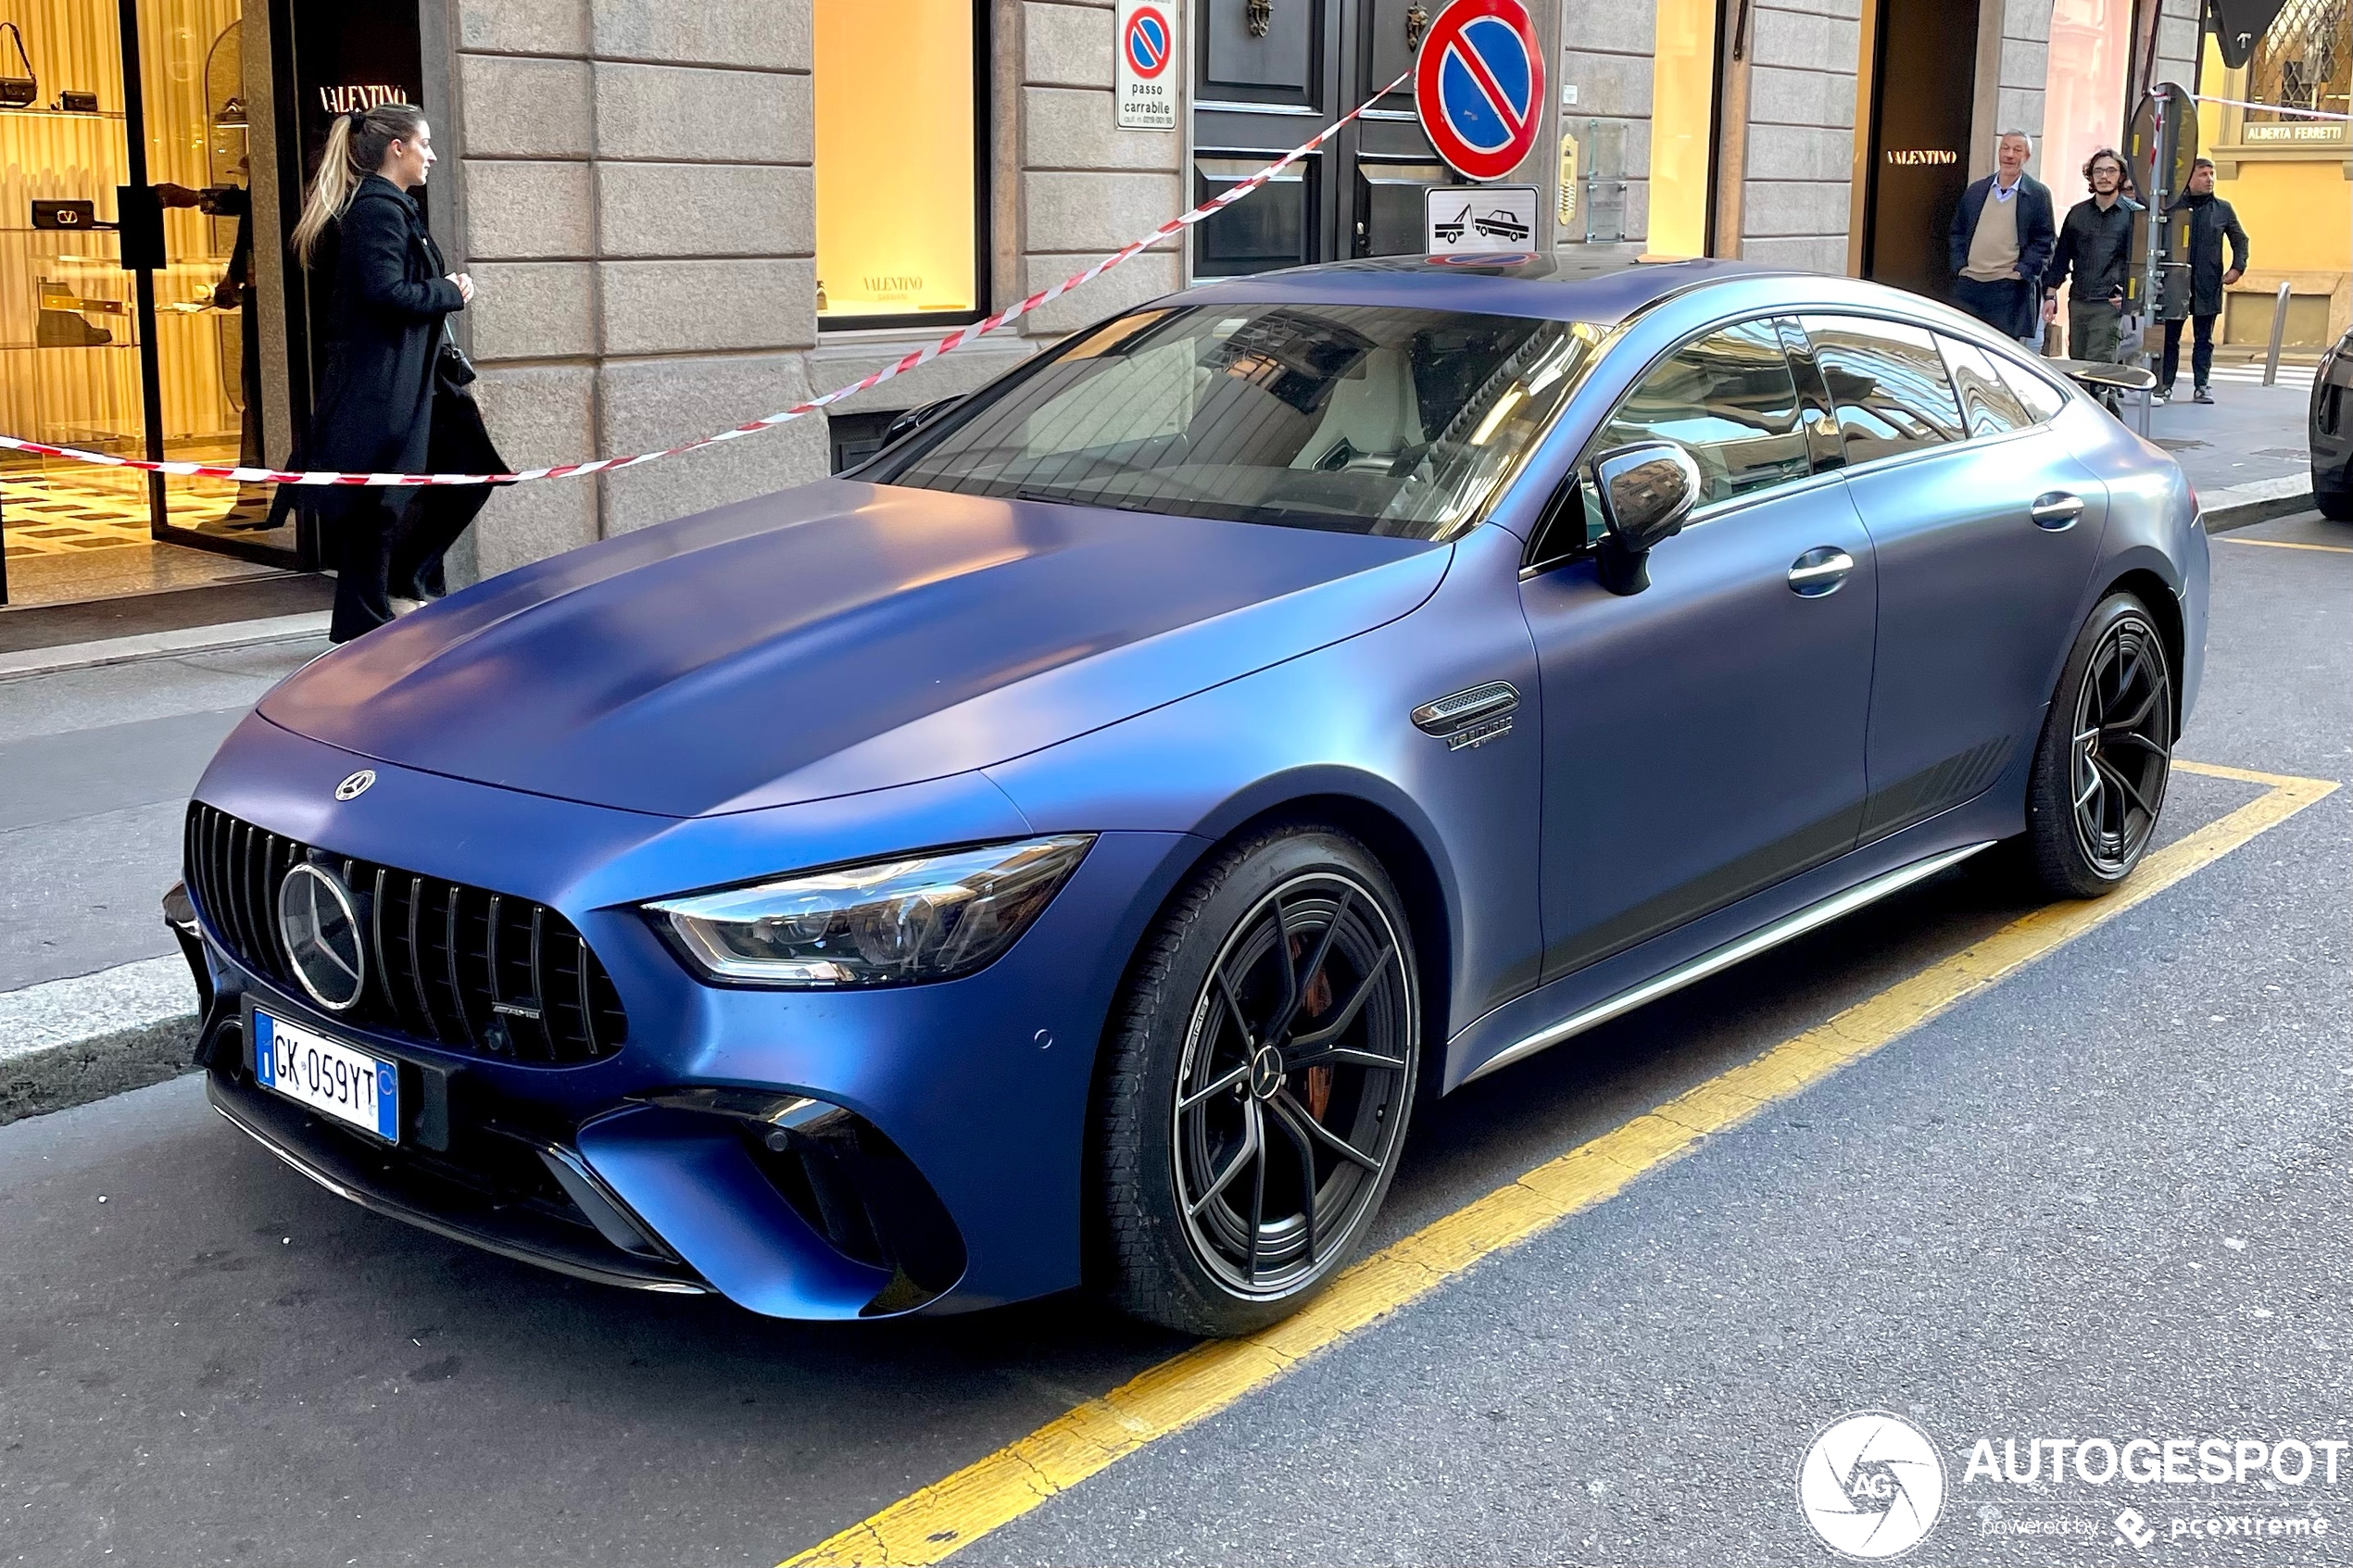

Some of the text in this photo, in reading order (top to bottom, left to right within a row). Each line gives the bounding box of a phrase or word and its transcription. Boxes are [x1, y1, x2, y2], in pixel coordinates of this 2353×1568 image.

[1132, 84, 1163, 96] passo
[320, 84, 408, 113] VALENTINO
[1125, 101, 1170, 114] carrabile
[2247, 126, 2342, 140] ALBERTA FERRETTI
[1887, 150, 1957, 165] VALENTINO
[863, 277, 923, 292] VALENTINO
[274, 1035, 375, 1110] GK 059YT
